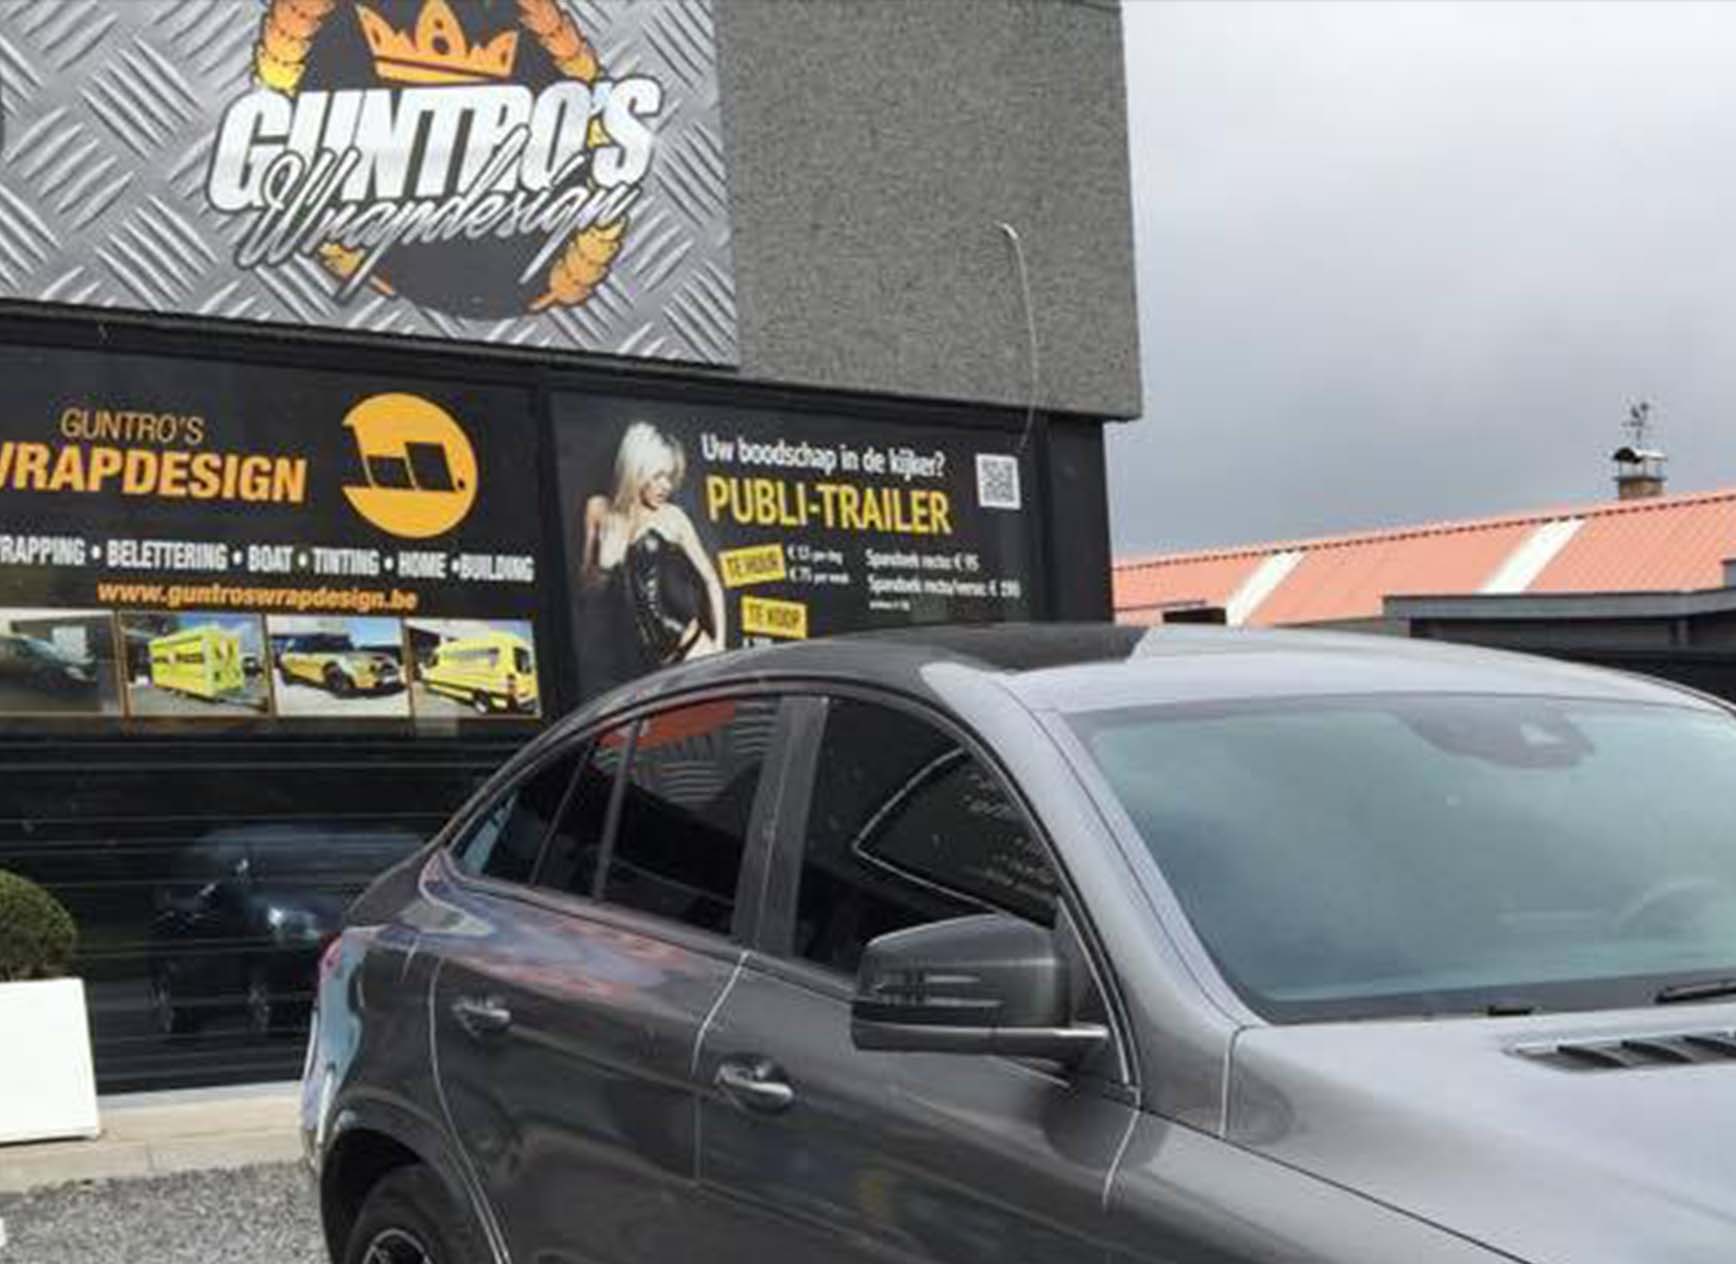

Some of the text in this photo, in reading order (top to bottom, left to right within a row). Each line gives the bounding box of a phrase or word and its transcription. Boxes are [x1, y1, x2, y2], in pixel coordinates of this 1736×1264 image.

[61, 408, 205, 445] GUNTRO'S
[701, 433, 946, 481] Uw boodschap in de kijker?
[706, 474, 952, 535] PUBLI-TRAILER
[0, 534, 534, 582] RAPPING BELETTERING BOAT TINTING HOME BUILDING
[98, 580, 418, 612] www.guntroswrapdesign.be
